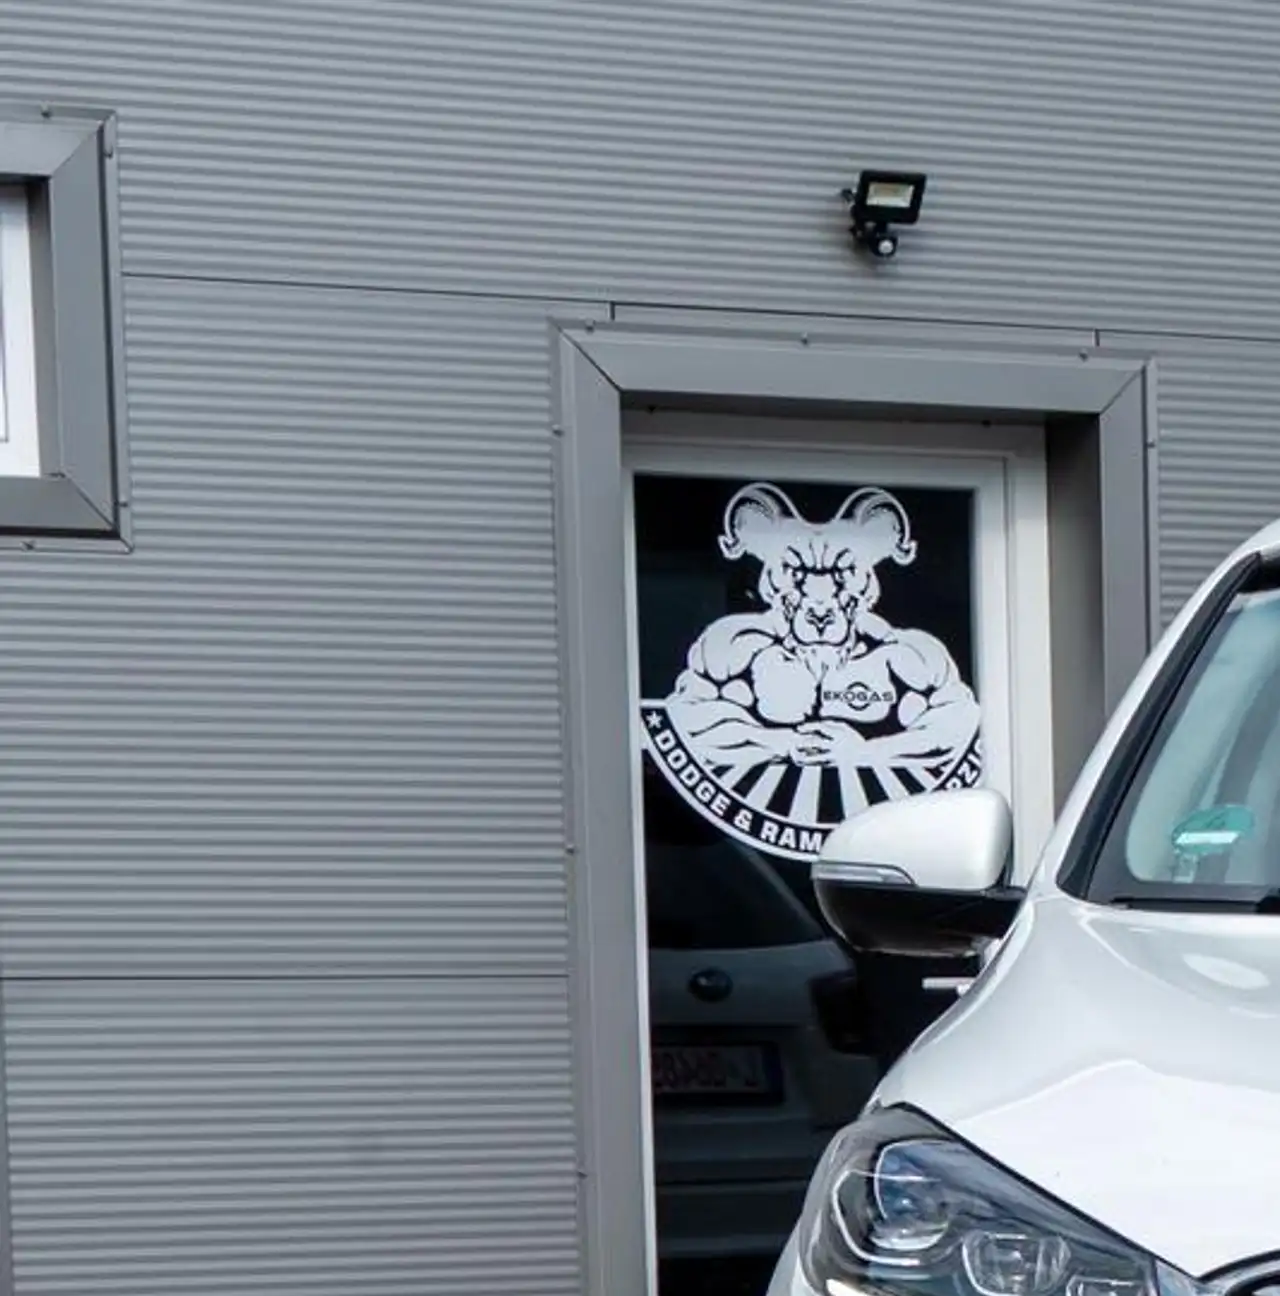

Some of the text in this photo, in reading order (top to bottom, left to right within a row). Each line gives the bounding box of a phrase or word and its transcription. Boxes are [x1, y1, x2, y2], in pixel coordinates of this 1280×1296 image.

[823, 690, 894, 702] EKOGAS
[655, 729, 823, 851] DODGE & RAM
